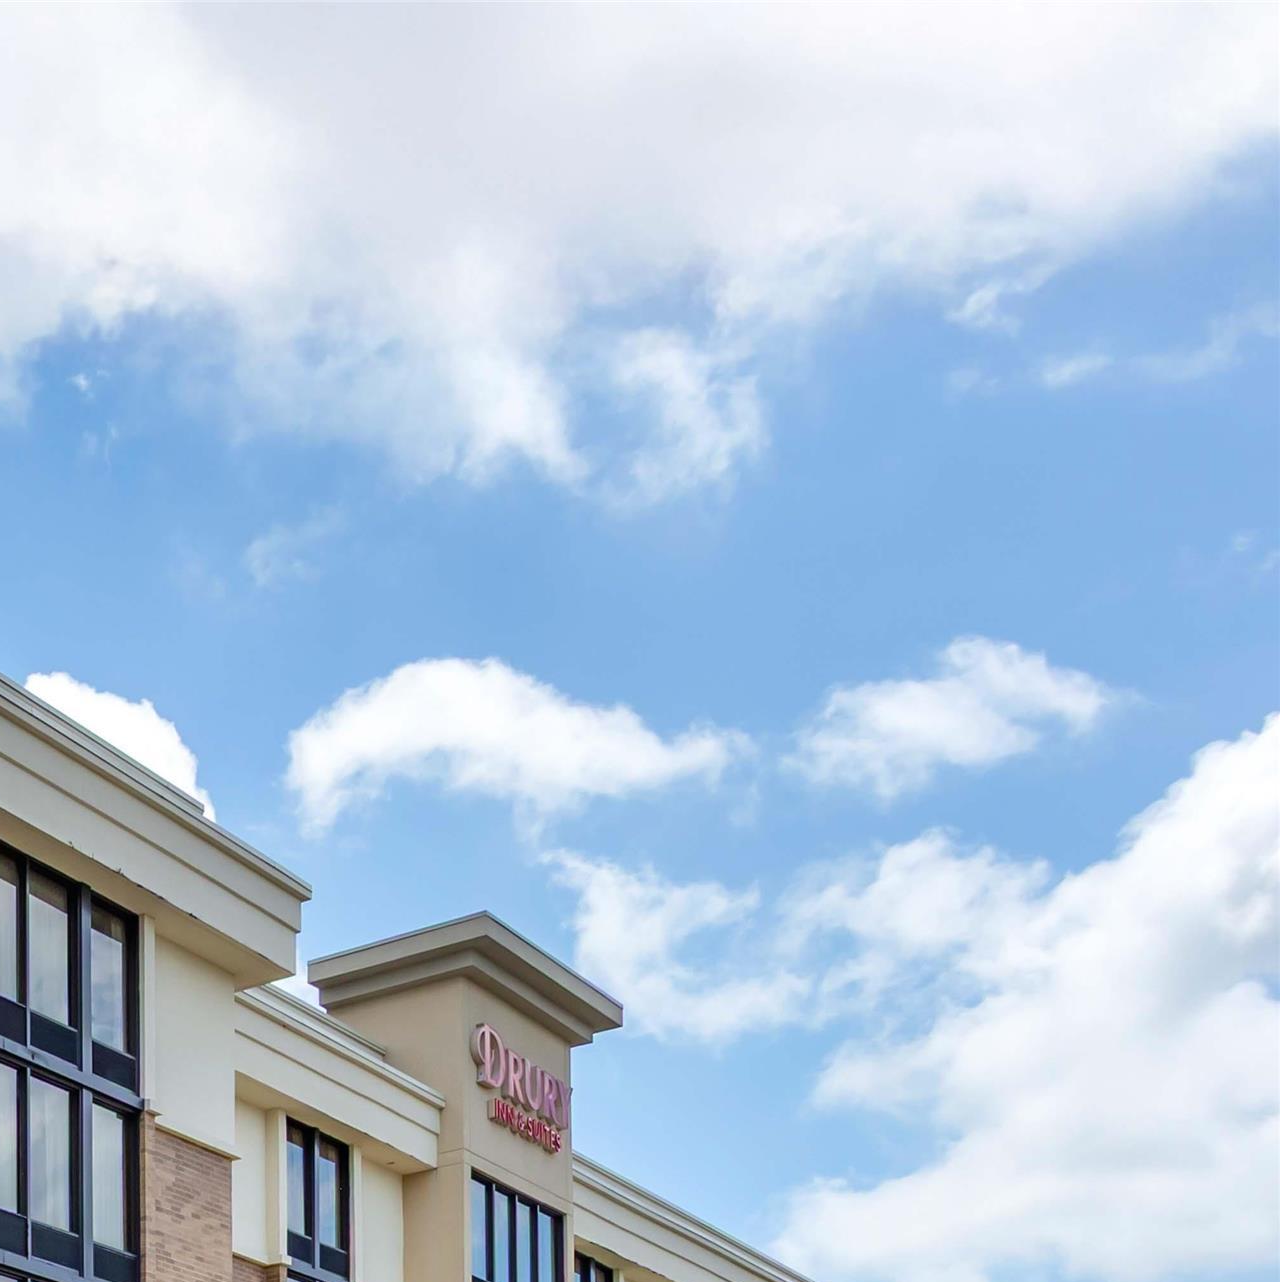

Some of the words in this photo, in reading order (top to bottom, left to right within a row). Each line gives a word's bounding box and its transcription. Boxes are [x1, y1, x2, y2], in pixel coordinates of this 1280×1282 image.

[470, 1023, 572, 1130] DRURY
[488, 1098, 515, 1128] INN
[526, 1117, 562, 1154] SUITES
